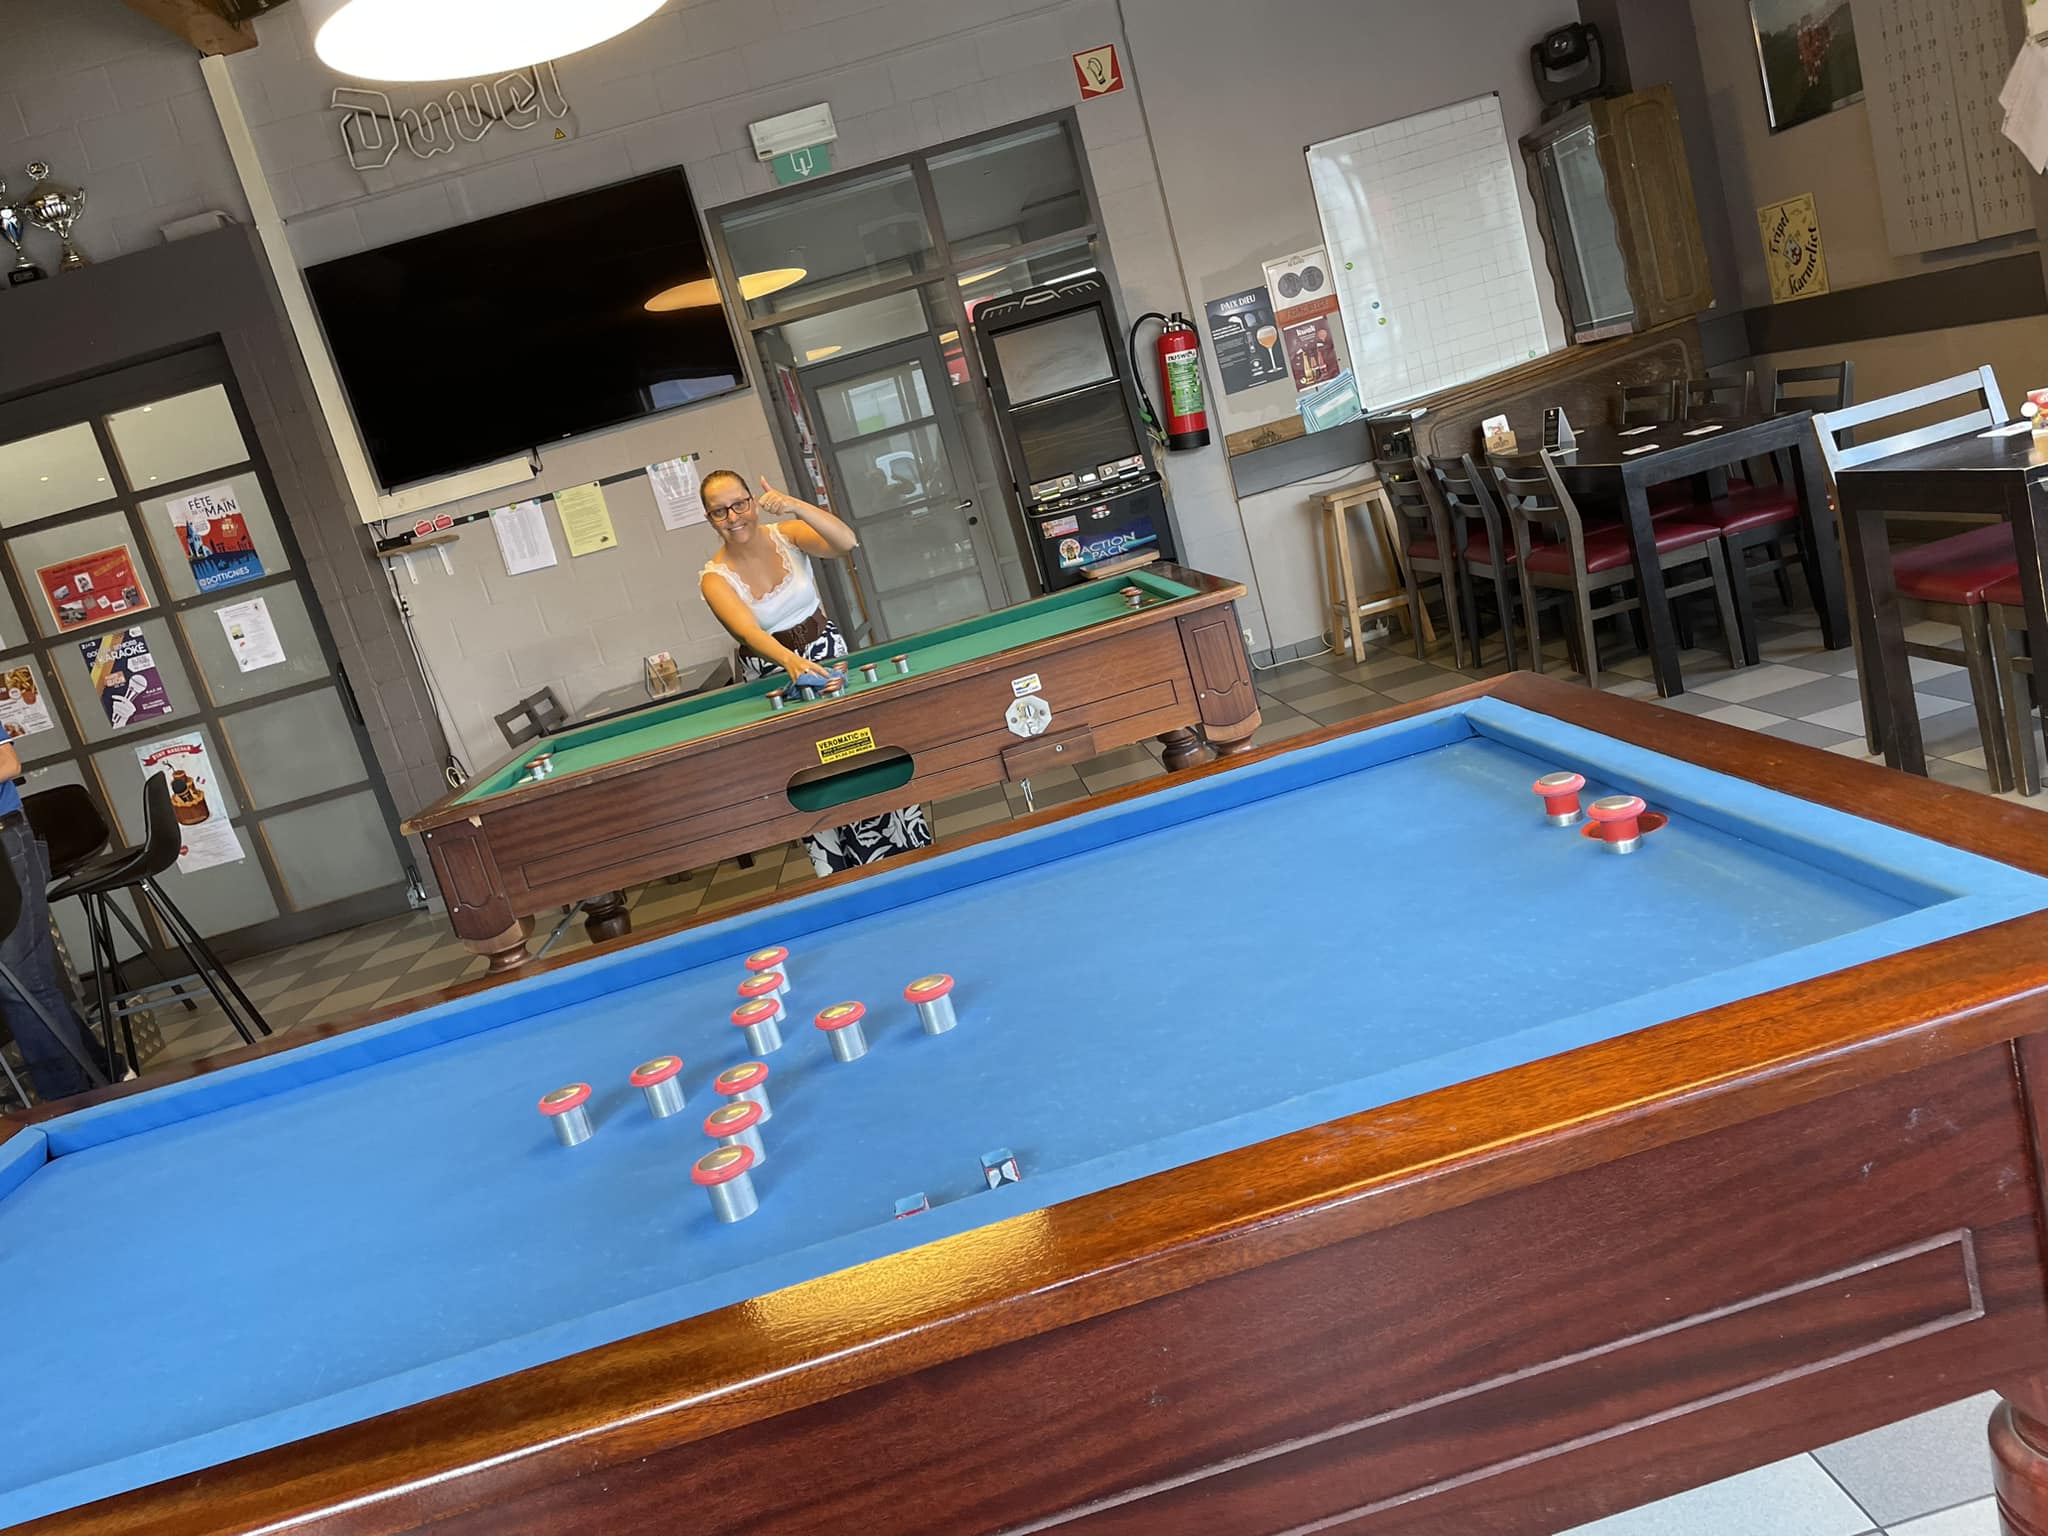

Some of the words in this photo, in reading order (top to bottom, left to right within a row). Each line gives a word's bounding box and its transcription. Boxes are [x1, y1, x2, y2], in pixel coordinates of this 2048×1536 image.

[331, 61, 568, 170] Duvel
[1220, 300, 1238, 312] PAIX
[1239, 294, 1256, 306] DIEU
[188, 495, 212, 511] FÊTE
[205, 499, 237, 518] MAIN
[1081, 531, 1136, 555] ACTION
[1092, 545, 1128, 560] PACK
[206, 566, 250, 586] DOTTIGNIES
[819, 732, 860, 750] VEROMATIC
